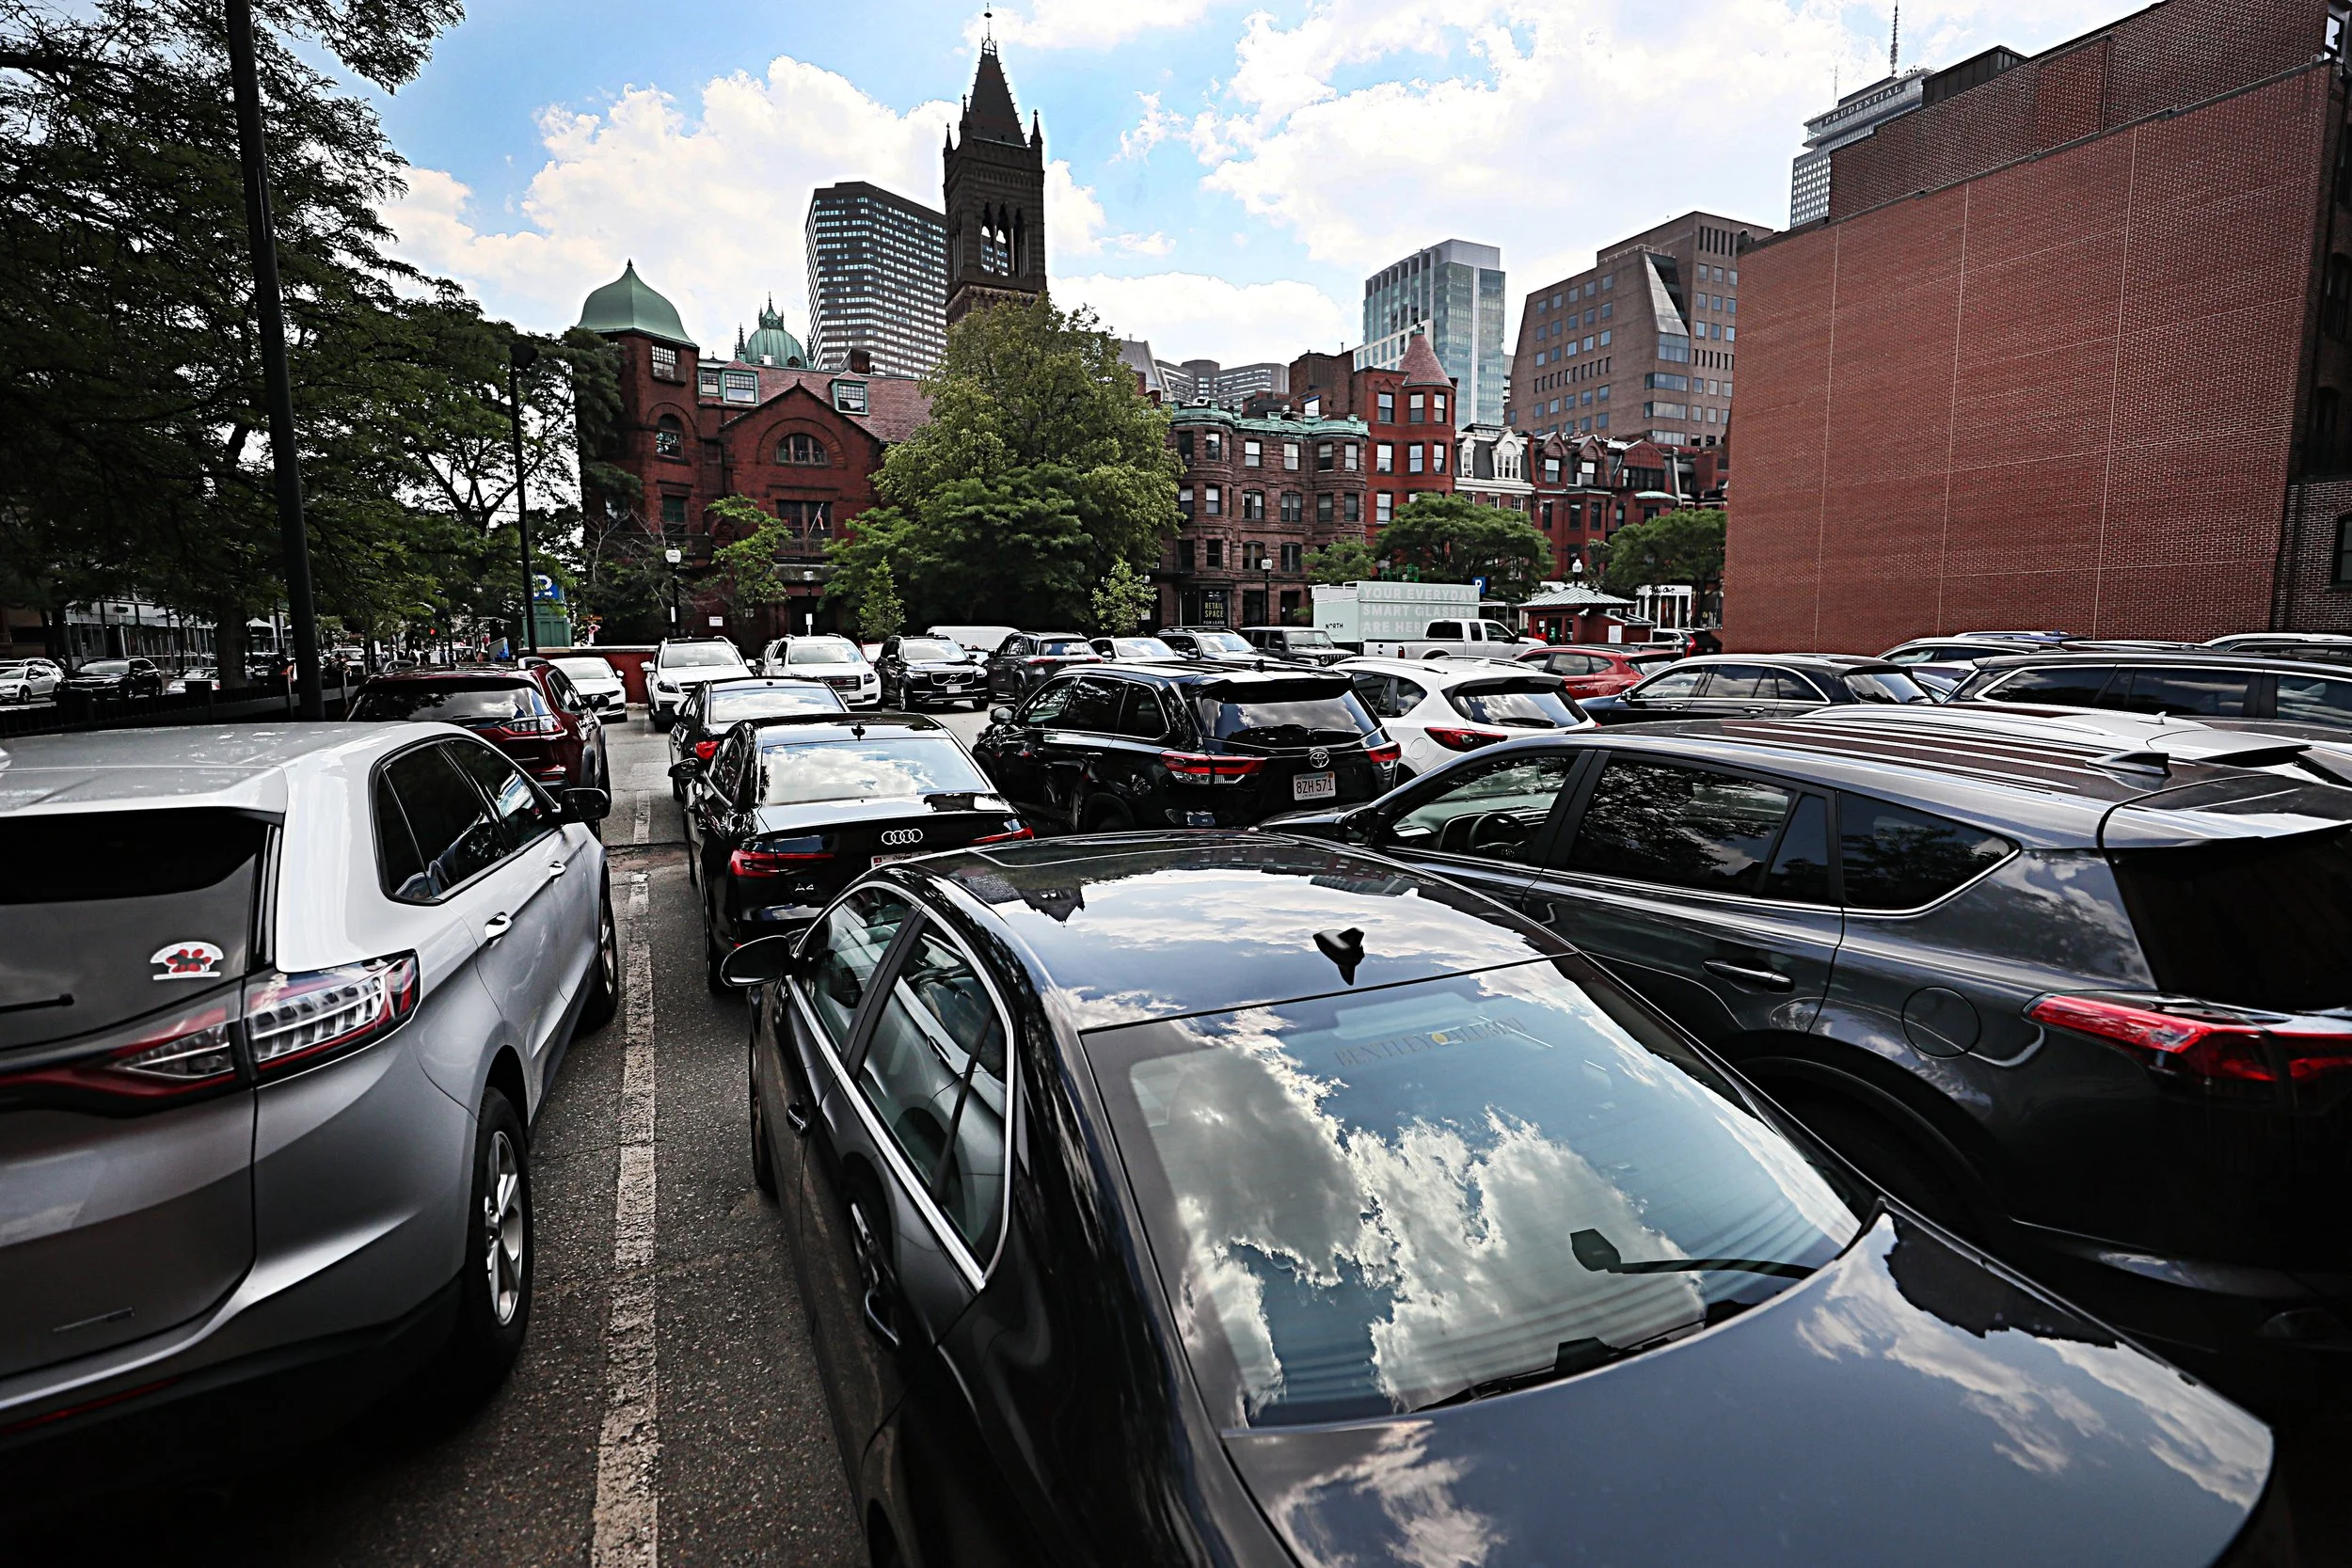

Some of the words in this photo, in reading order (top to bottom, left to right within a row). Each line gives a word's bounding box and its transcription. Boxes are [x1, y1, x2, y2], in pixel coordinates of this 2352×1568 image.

[1824, 86, 1901, 124] PRUDENTIAL
[1363, 586, 1402, 599] YOUR
[1406, 588, 1475, 601] EVERYDAY
[1362, 605, 1410, 617] SMART
[1415, 606, 1473, 618] GLASSES
[1362, 621, 1390, 633] ARE
[1296, 781, 1314, 794] 8ZH
[1315, 779, 1333, 791] 571
[795, 882, 815, 892] A4
[1333, 1031, 1433, 1068] BENTLEY
[1449, 1017, 1528, 1044] ALUMNI
